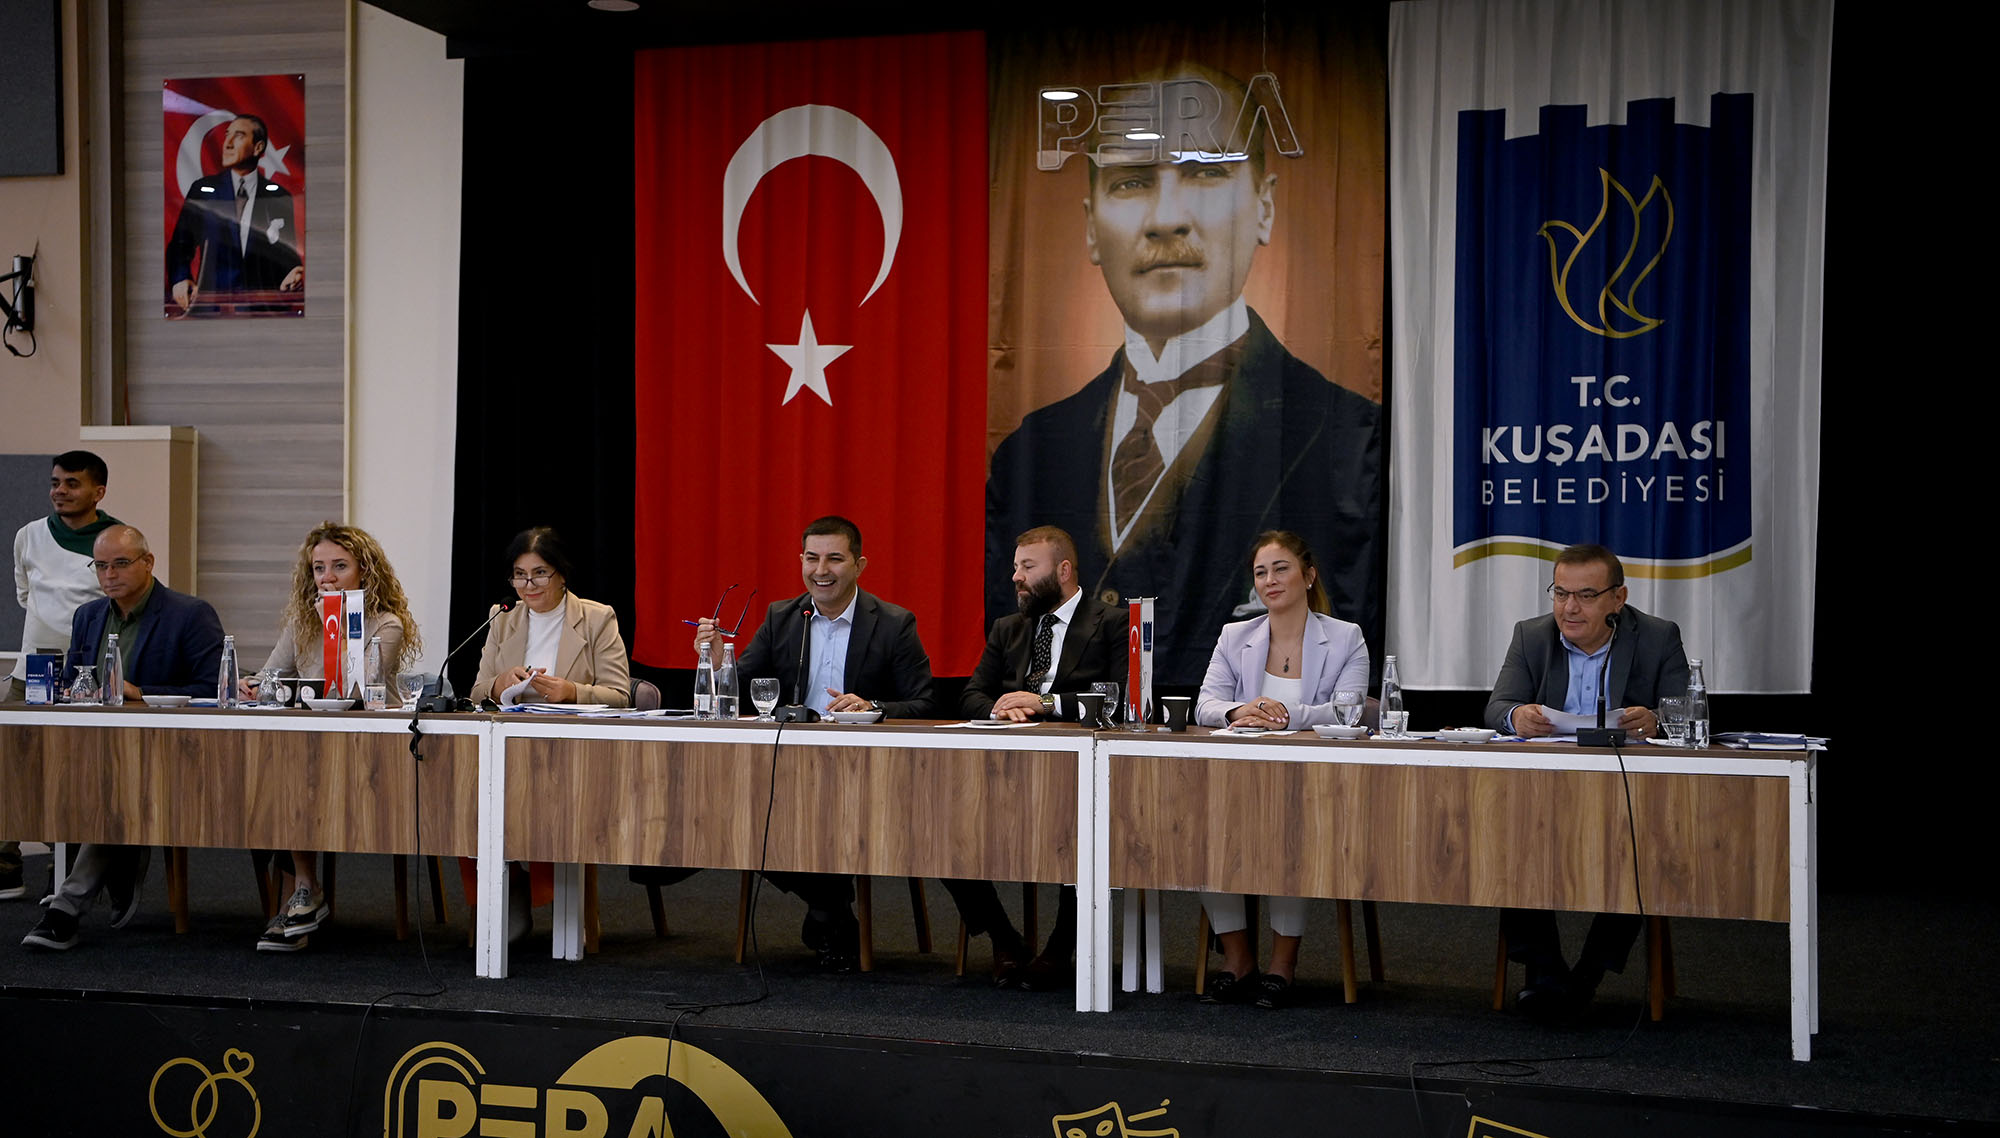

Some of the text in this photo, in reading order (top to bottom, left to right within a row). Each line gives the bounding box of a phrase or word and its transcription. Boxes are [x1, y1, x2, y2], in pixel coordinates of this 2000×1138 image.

[1037, 72, 1302, 170] PERA
[1570, 374, 1641, 407] T.C.
[1481, 420, 1725, 466] KUŞADASI
[1481, 468, 1724, 505] BELEDİYESİ
